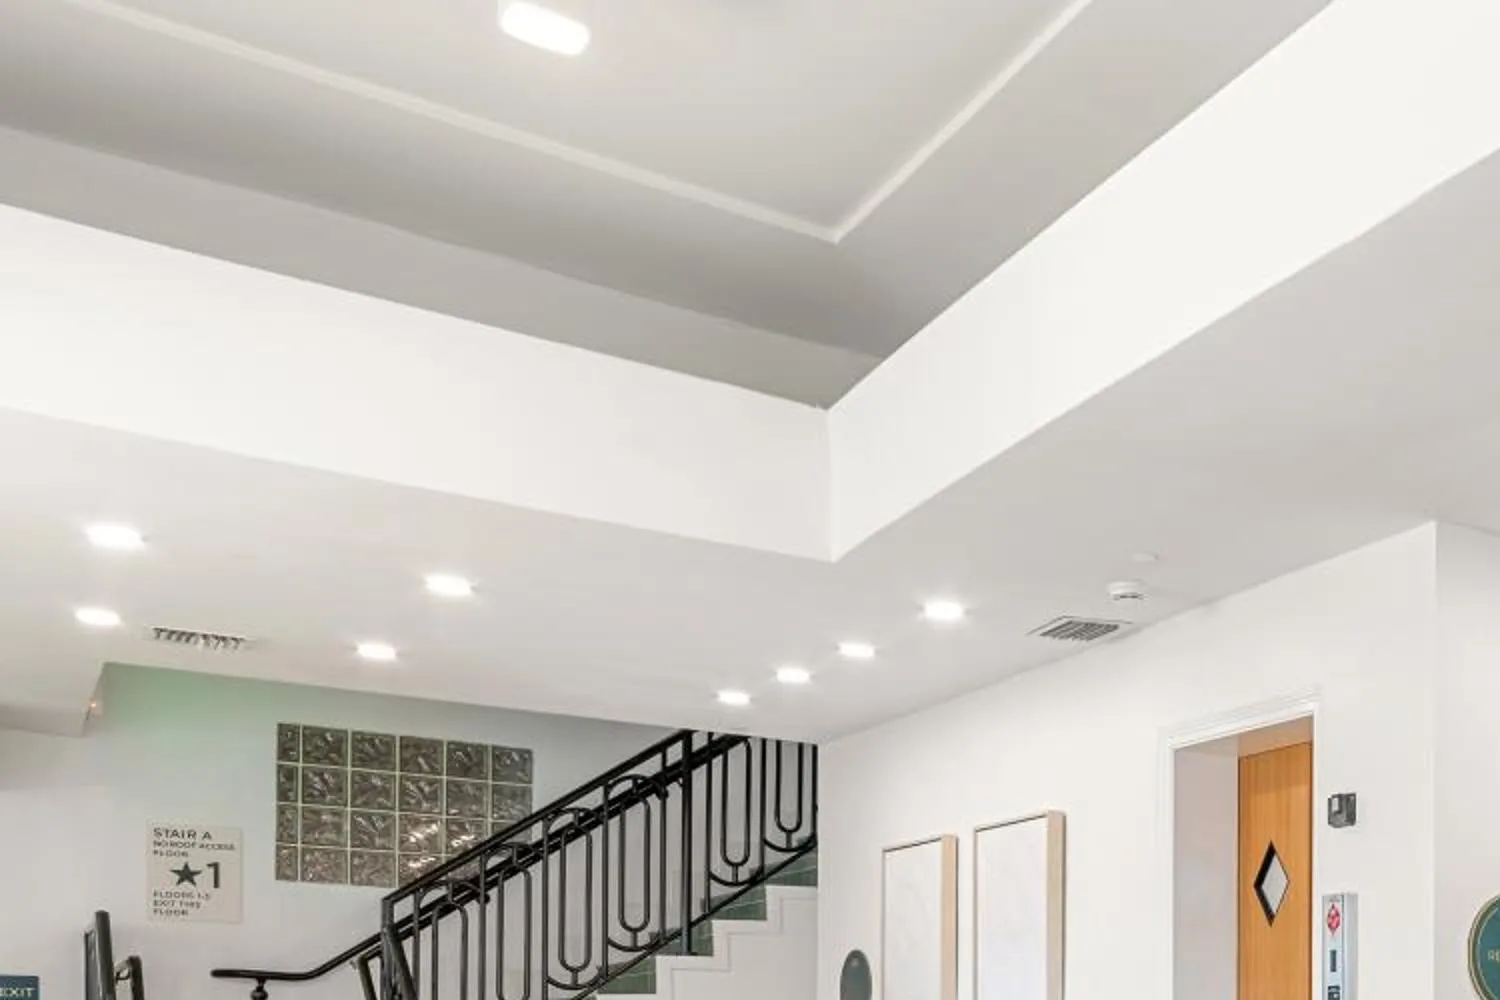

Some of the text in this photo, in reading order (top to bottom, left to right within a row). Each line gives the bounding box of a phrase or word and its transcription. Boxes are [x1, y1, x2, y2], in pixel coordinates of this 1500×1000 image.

[153, 827, 212, 841] STAIR A
[206, 861, 221, 889] 1
